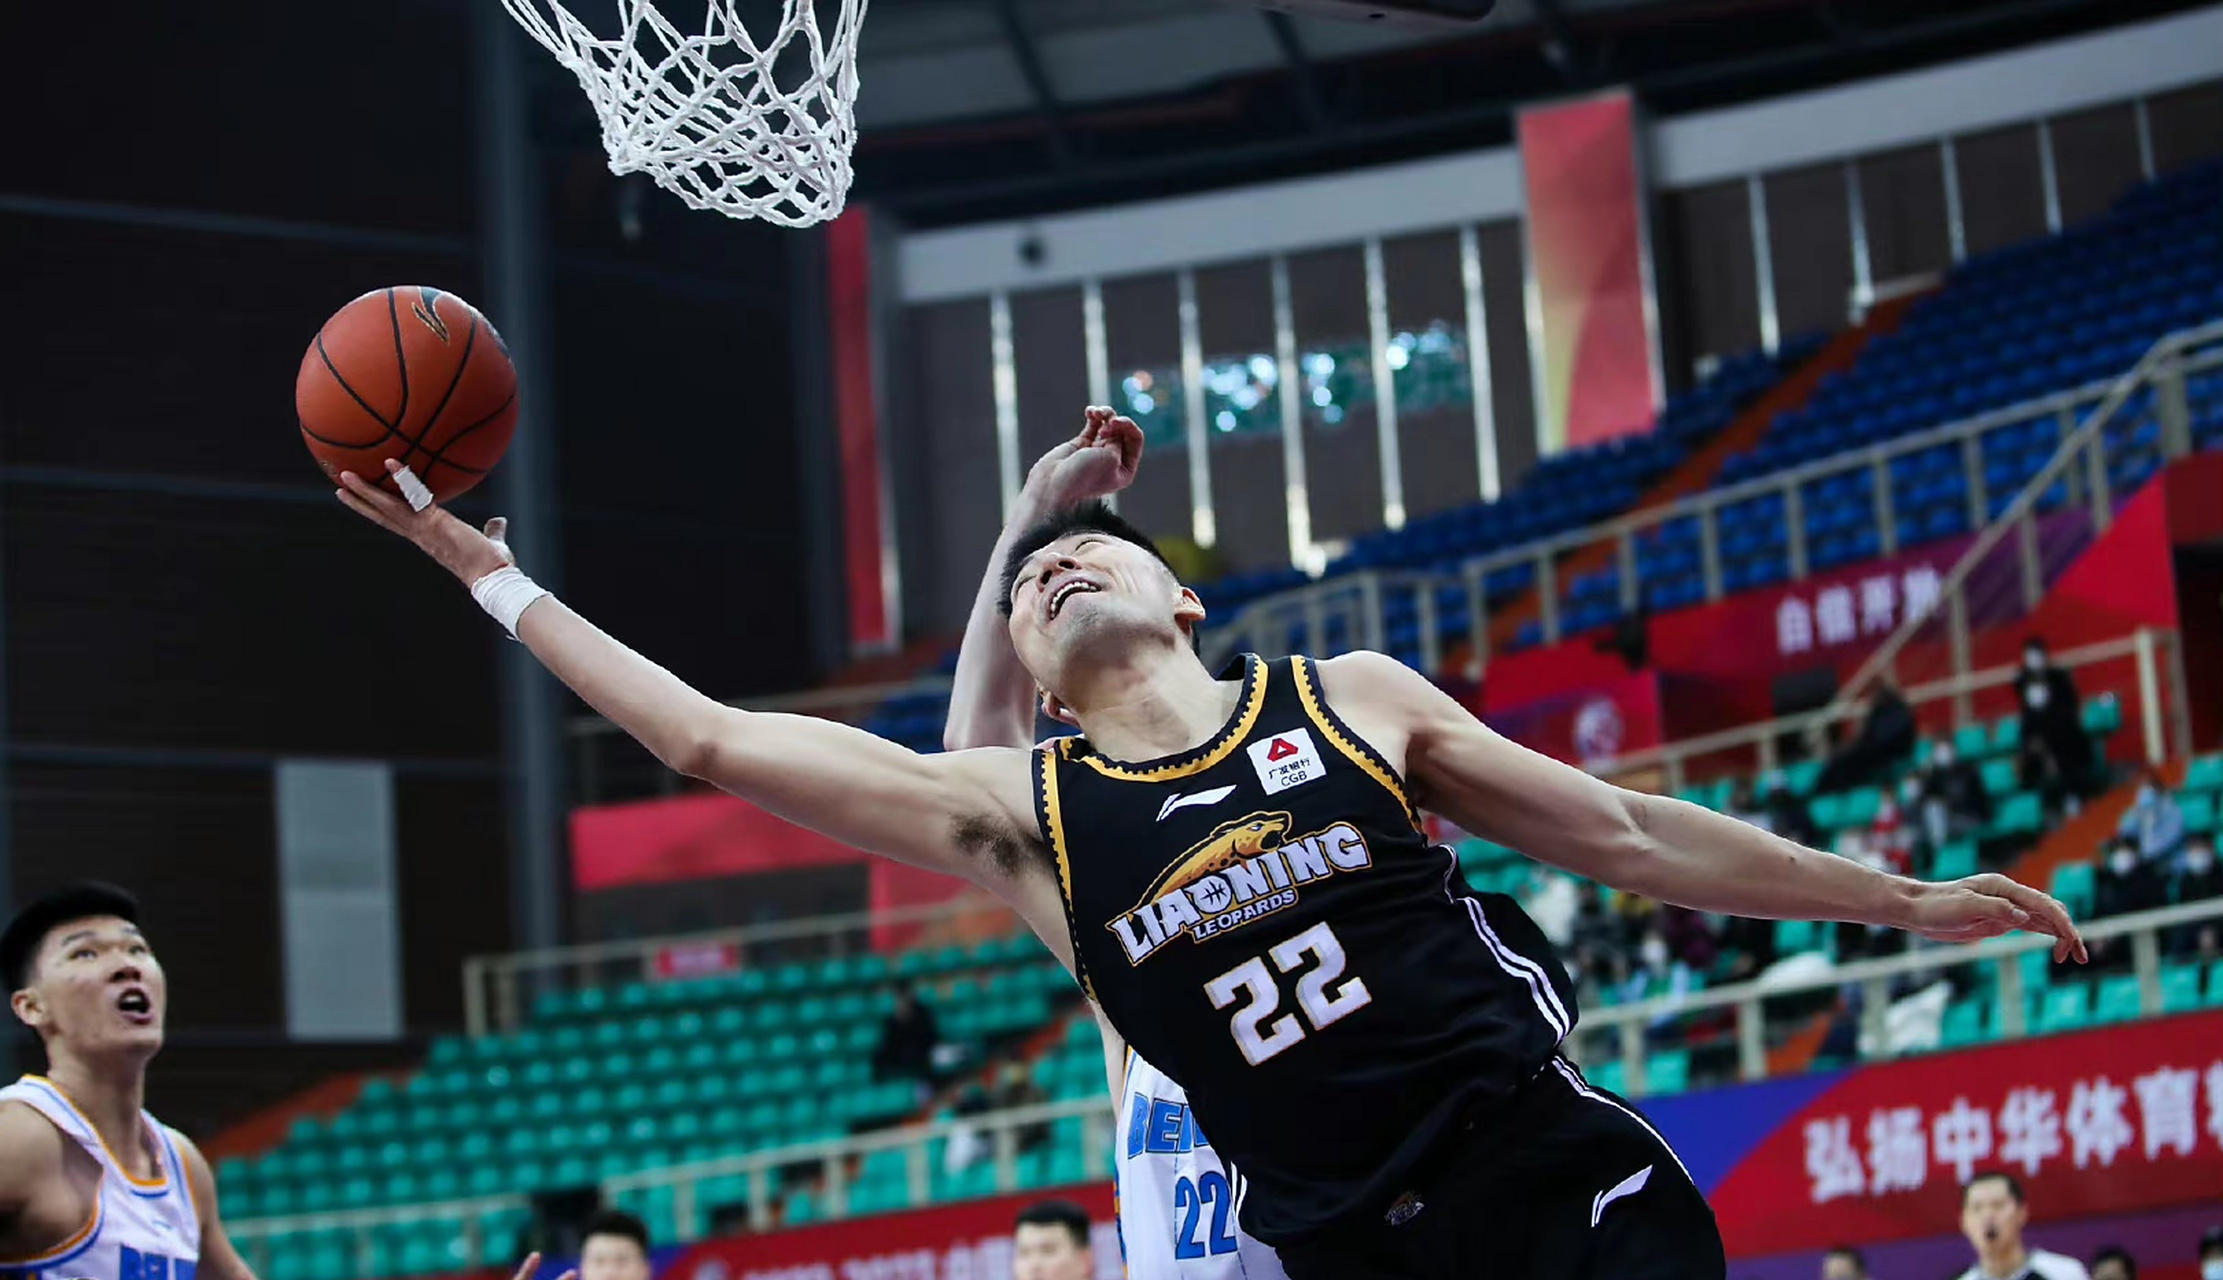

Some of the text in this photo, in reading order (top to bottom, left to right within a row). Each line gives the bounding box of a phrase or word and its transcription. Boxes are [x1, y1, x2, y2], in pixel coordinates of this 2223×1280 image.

[1269, 757, 1311, 779] 广发银行
[1281, 770, 1308, 787] CGB
[1108, 822, 1371, 964] LIAONING
[1194, 889, 1296, 940] LEOPARDS
[1203, 921, 1372, 1066] 22
[1175, 1170, 1238, 1260] 22
